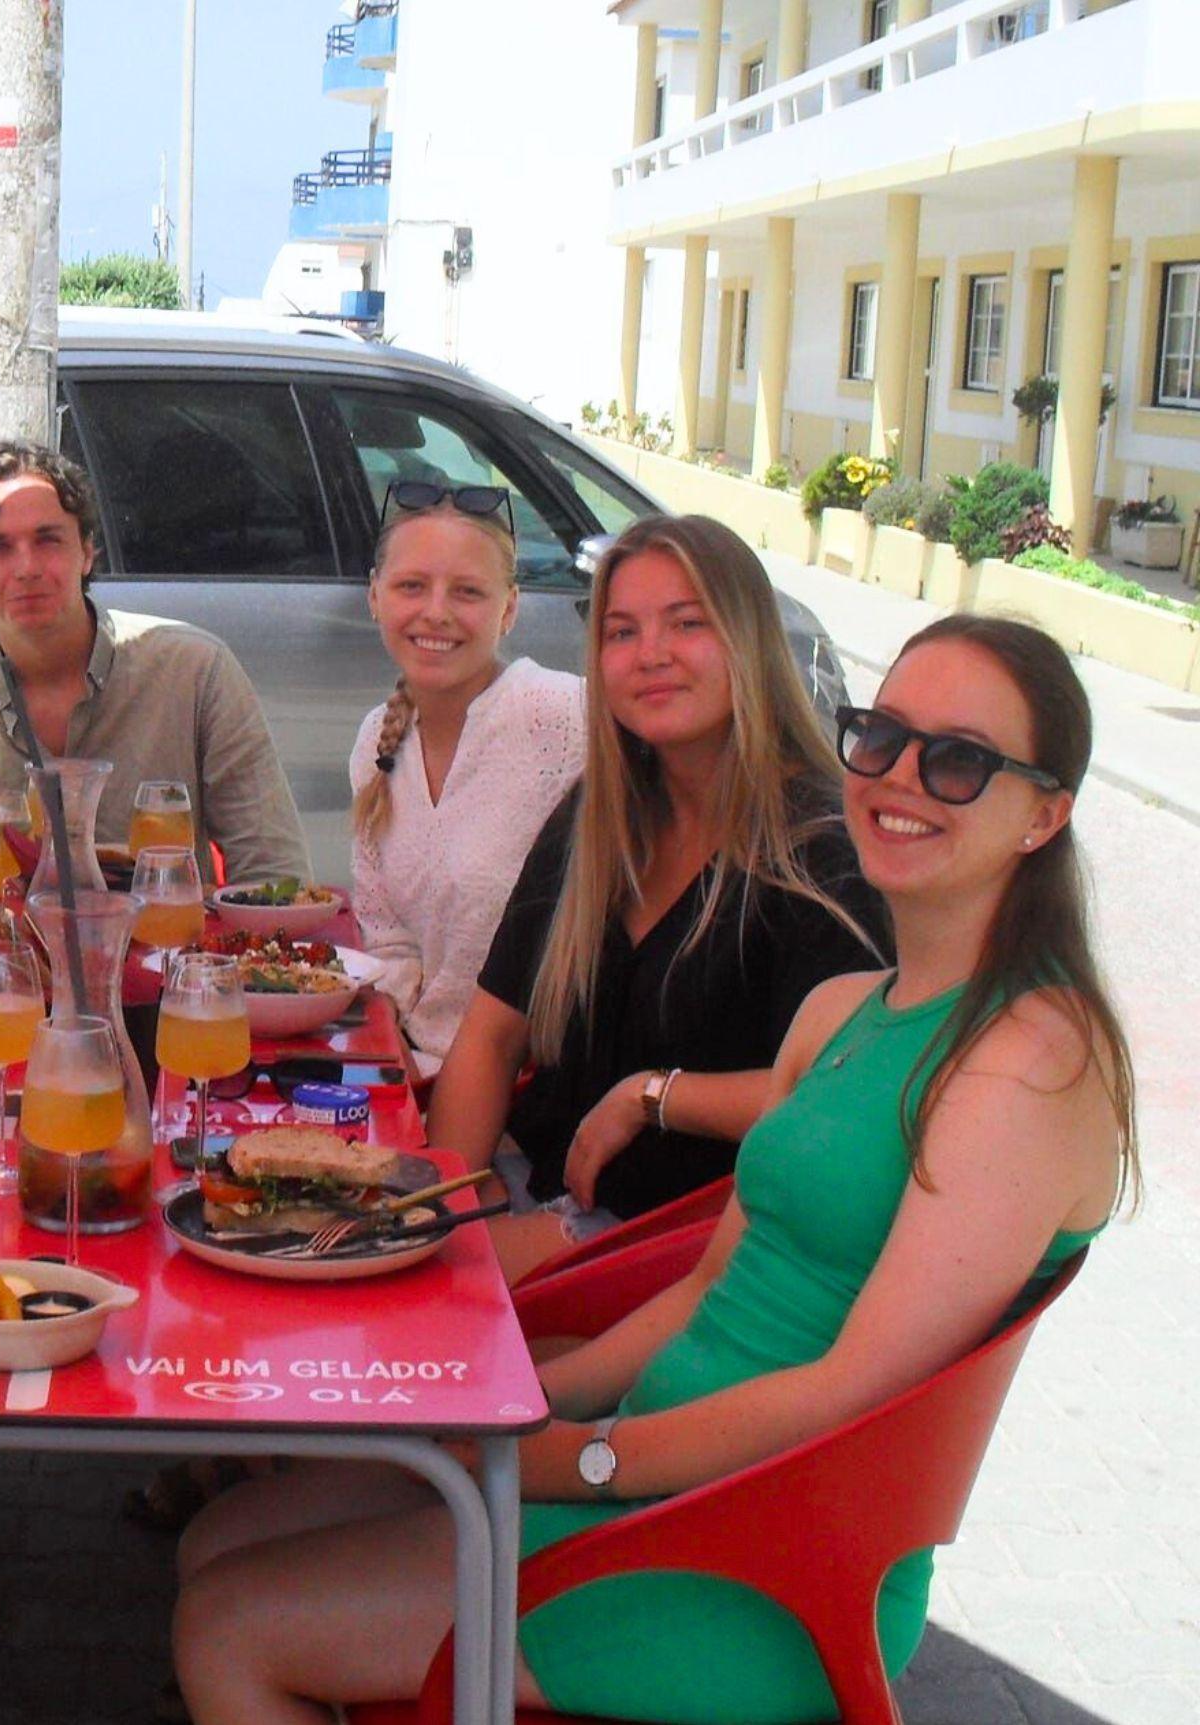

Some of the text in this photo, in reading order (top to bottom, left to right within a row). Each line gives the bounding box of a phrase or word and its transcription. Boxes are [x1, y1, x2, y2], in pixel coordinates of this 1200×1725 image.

[204, 1358, 270, 1377] UM
[288, 1360, 468, 1380] GELADO?
[308, 1386, 414, 1404] OLÁ
